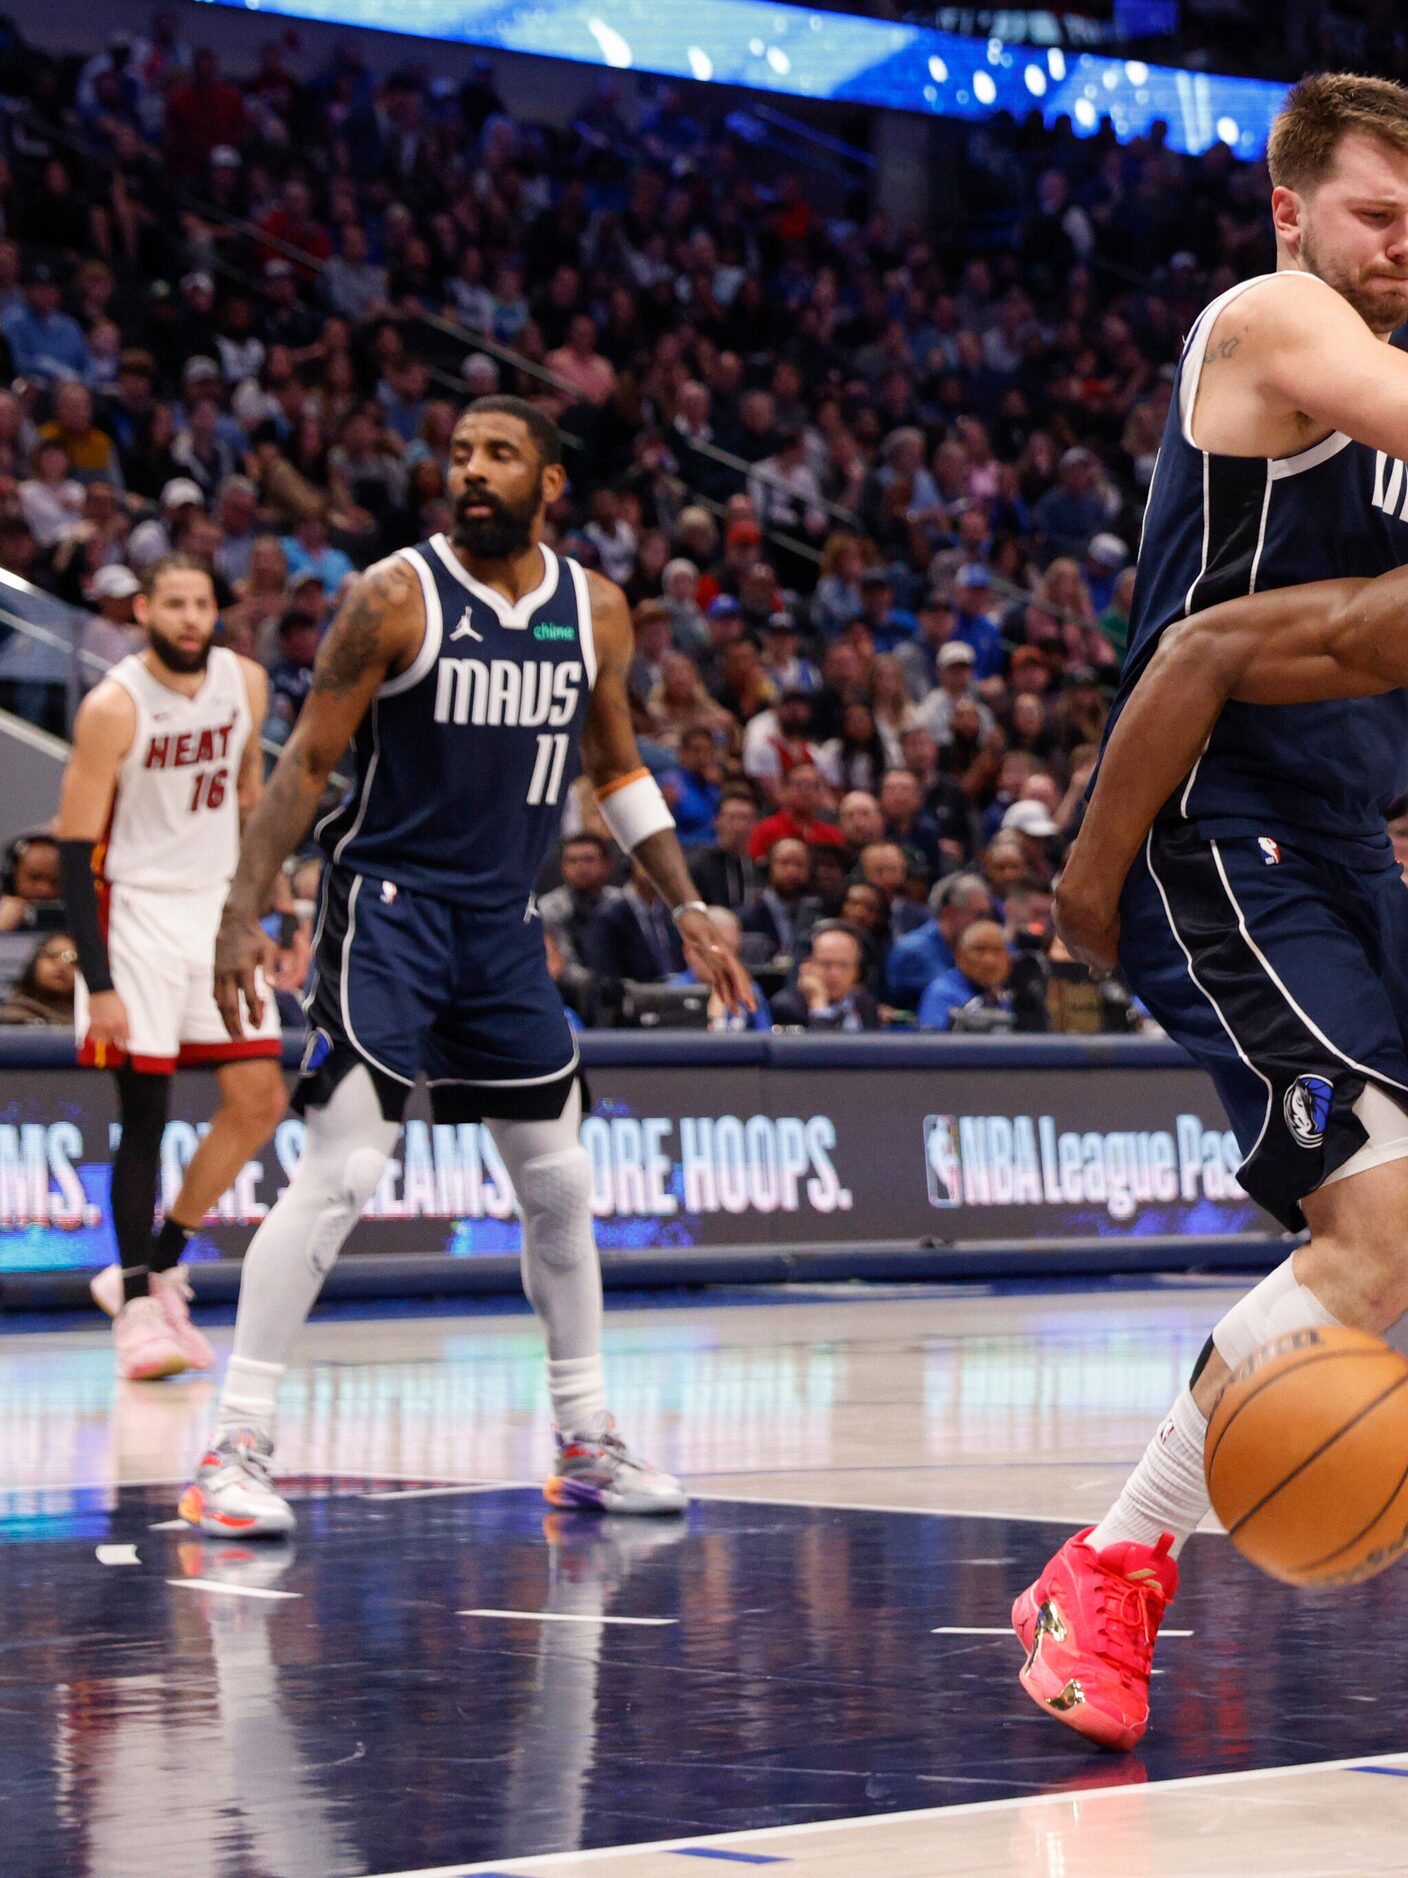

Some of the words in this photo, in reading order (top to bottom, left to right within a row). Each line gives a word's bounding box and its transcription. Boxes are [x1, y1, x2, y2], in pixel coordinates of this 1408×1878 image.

[533, 622, 575, 641] chime
[434, 657, 581, 728] MAVS
[144, 713, 237, 769] HEAT
[526, 733, 569, 806] 11
[191, 768, 228, 812] 16
[581, 1115, 678, 1215] ORE
[680, 1114, 853, 1214] HOOPS.
[959, 1115, 1043, 1206] NBA
[1039, 1114, 1180, 1220] League
[1176, 1113, 1249, 1202] Pas
